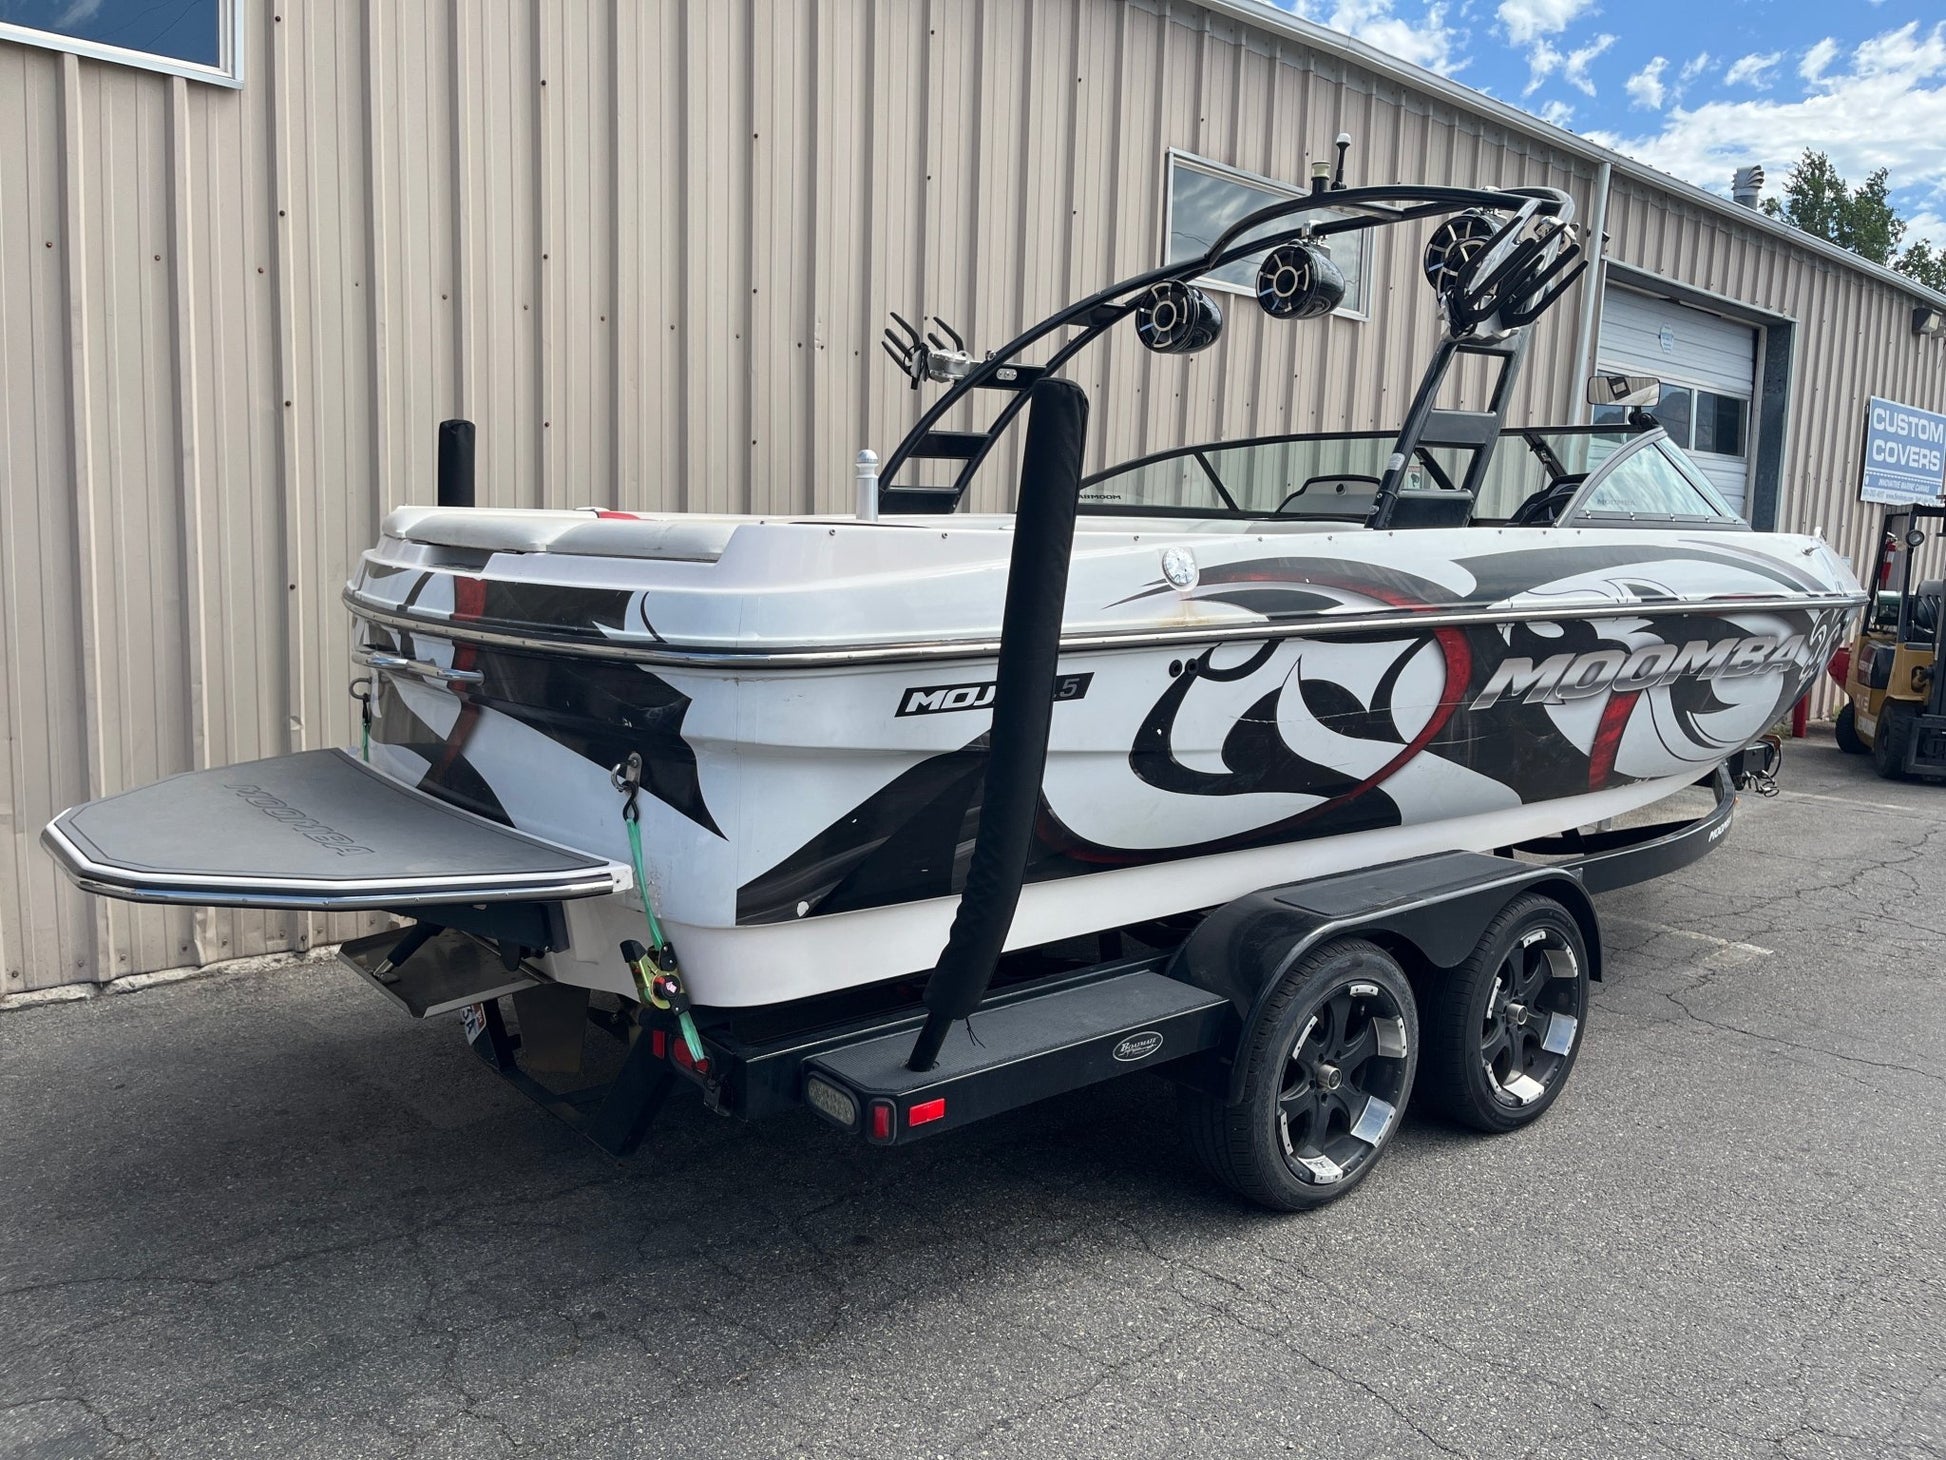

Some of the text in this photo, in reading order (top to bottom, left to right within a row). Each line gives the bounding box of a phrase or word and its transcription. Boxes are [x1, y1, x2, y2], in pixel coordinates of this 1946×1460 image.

[1873, 407, 1944, 444] CUSTOM
[1872, 439, 1940, 471] COVERS
[1468, 635, 1807, 711] MOOMBA
[905, 685, 996, 713] MOJ
[223, 784, 375, 857] MOOMBA
